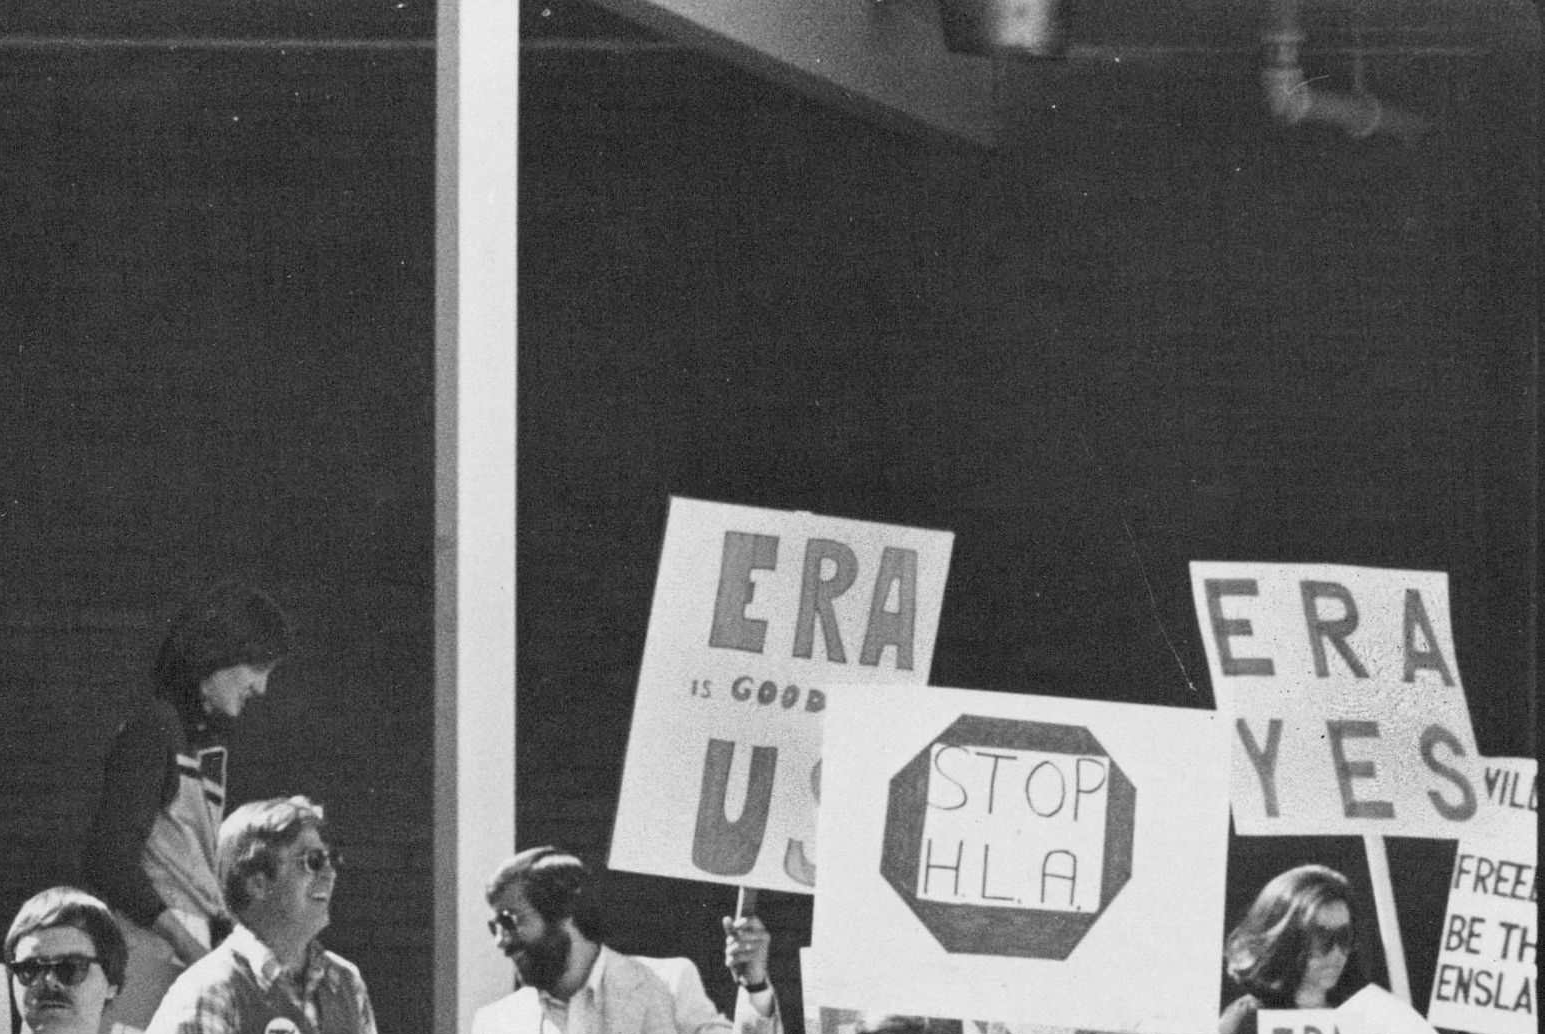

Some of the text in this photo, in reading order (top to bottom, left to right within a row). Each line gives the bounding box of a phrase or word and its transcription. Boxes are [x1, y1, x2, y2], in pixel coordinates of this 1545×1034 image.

[708, 530, 919, 671] ERA
[1204, 578, 1456, 688] ERA
[691, 675, 827, 713] IS GOOD
[926, 744, 1107, 822] STOP
[1235, 717, 1479, 823] YES
[1445, 913, 1486, 955] BE
[1436, 964, 1532, 1015] ENSLA
